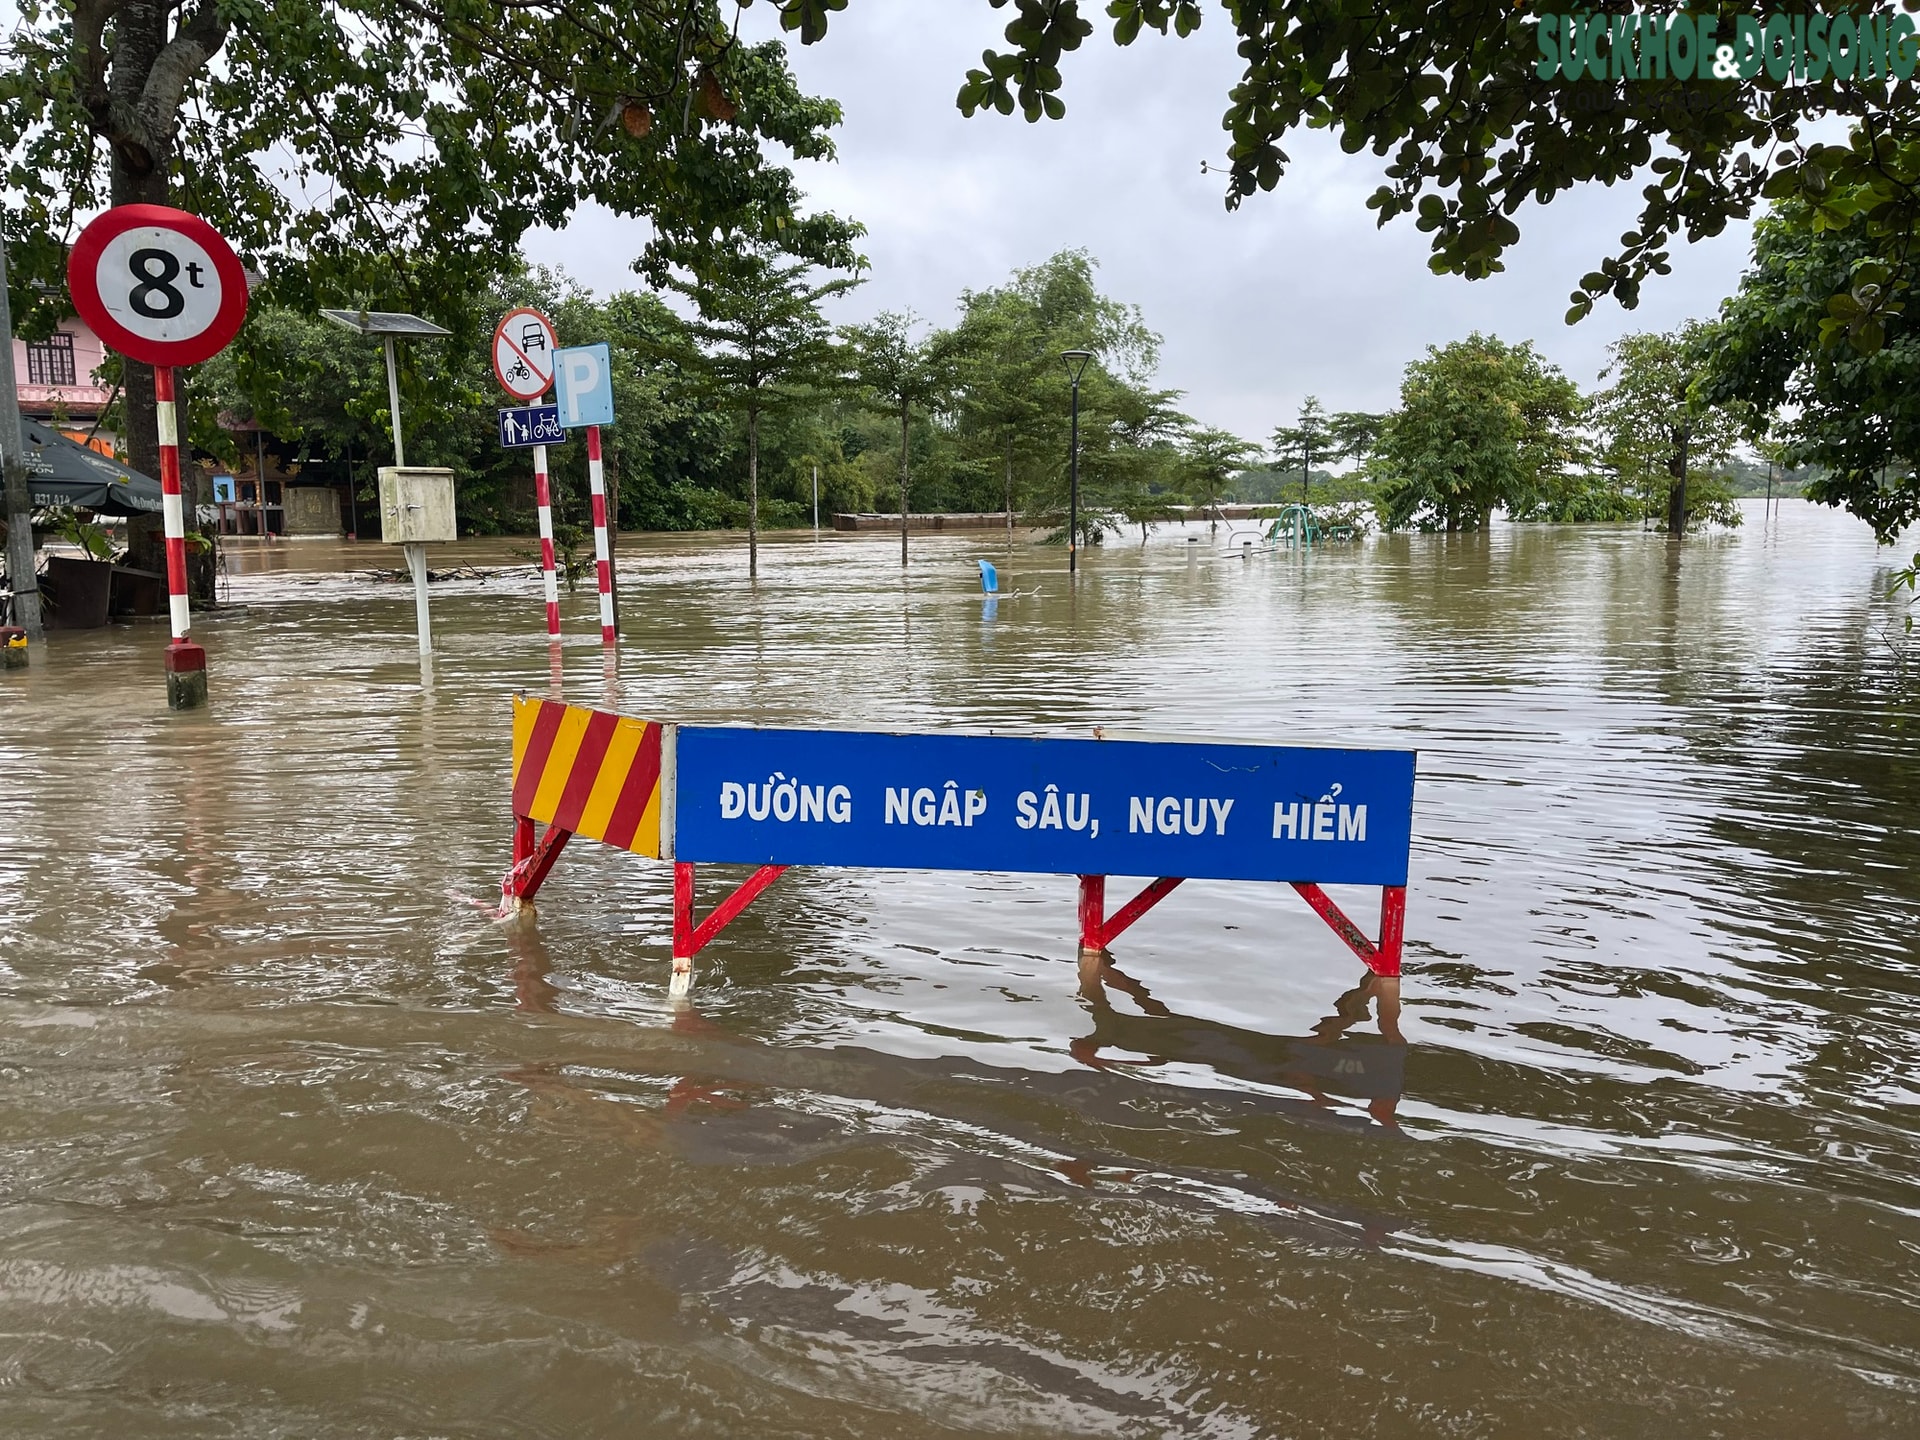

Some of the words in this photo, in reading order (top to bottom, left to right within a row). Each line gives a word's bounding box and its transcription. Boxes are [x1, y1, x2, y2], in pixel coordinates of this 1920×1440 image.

[563, 352, 599, 422] P
[34, 493, 51, 505] 931
[719, 771, 852, 824] ĐƯỜNG
[1015, 783, 1099, 839] SÂU,
[1129, 796, 1235, 836] NGUY
[1272, 782, 1368, 842] HIỂM
